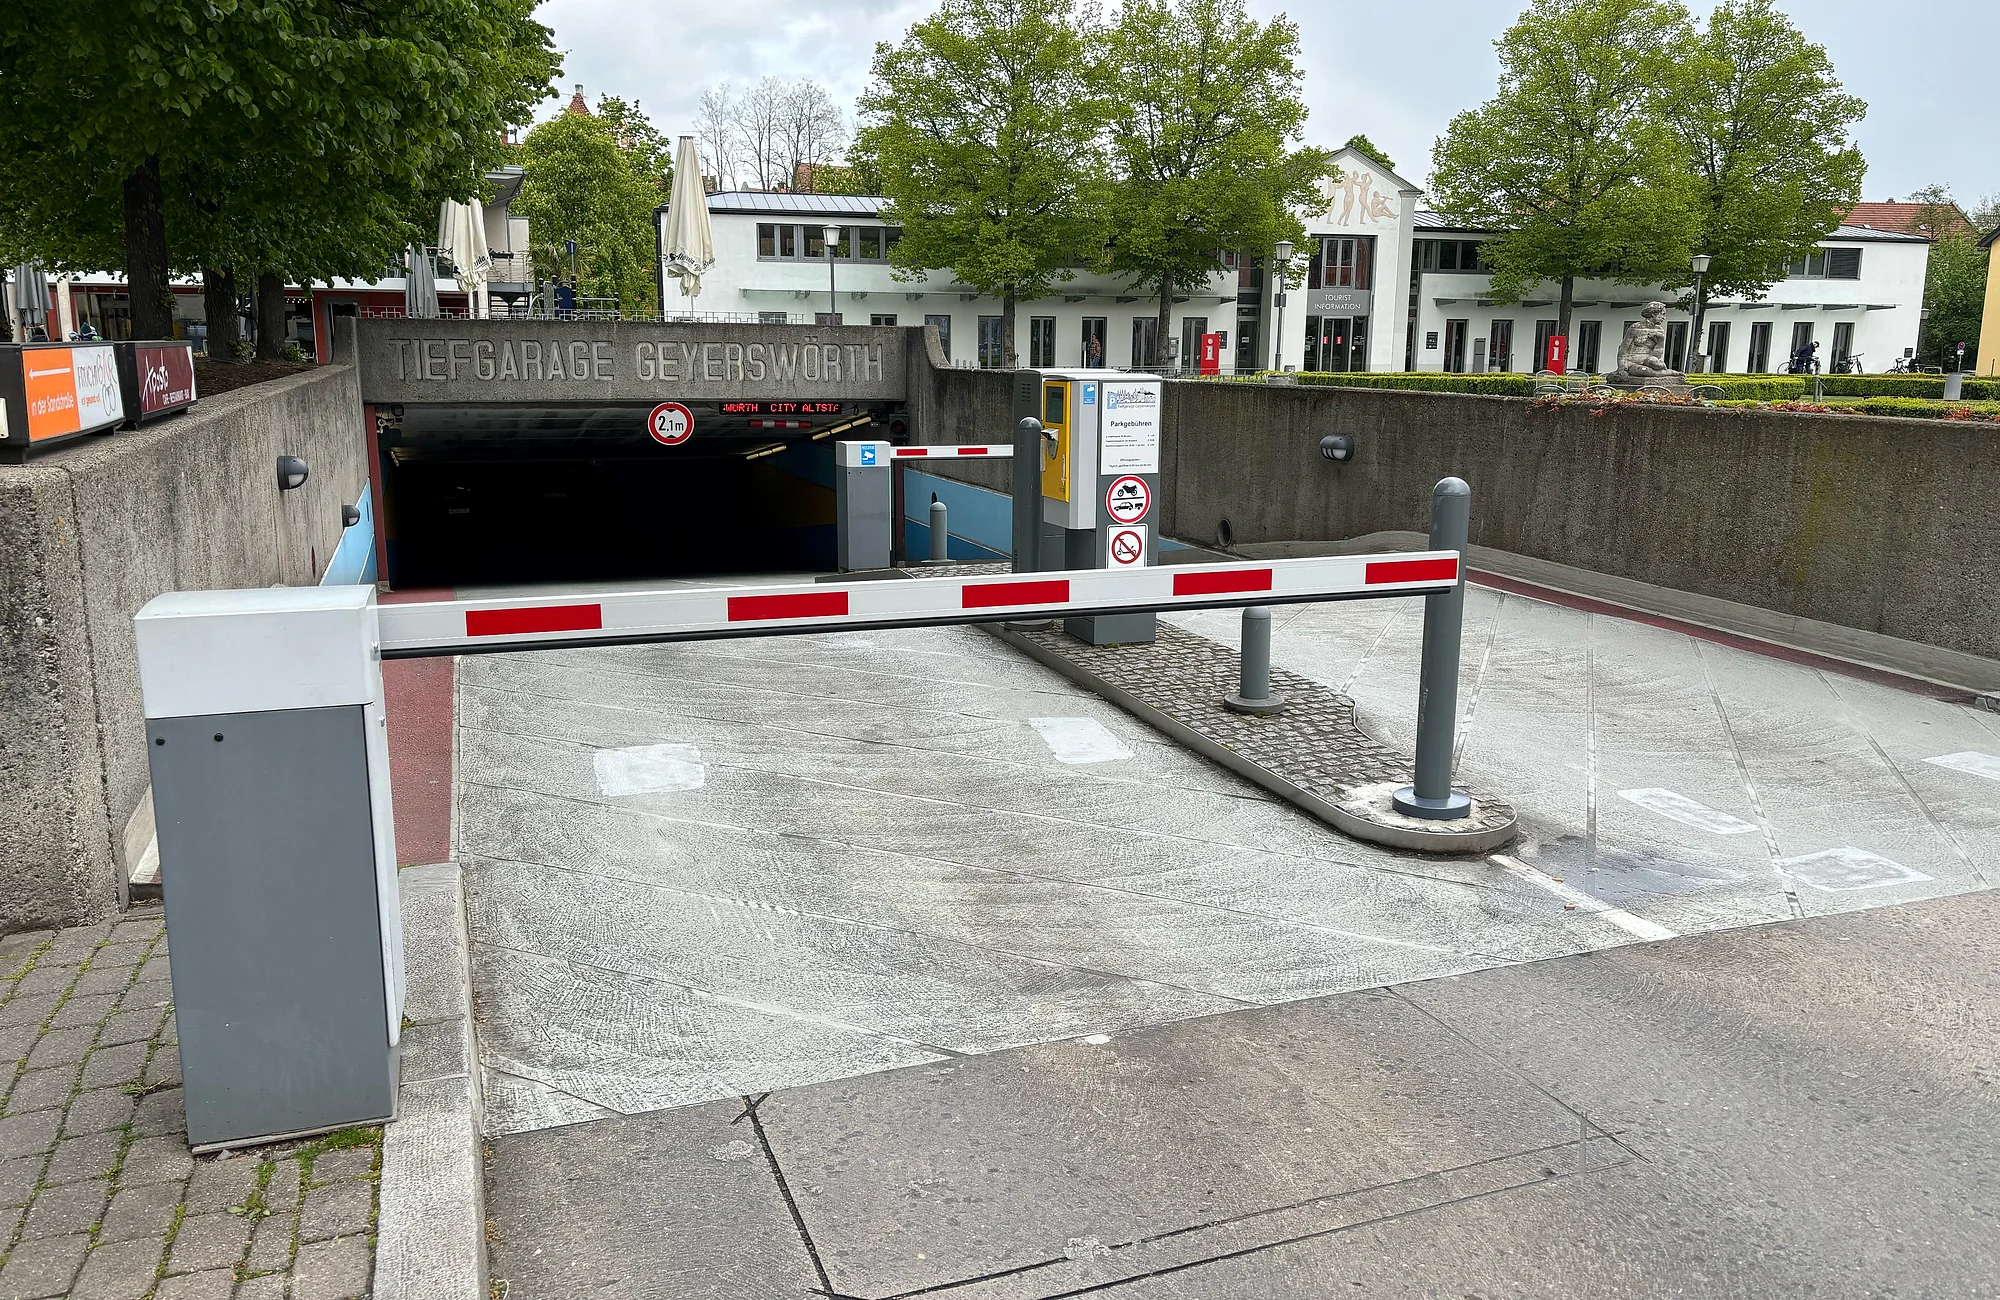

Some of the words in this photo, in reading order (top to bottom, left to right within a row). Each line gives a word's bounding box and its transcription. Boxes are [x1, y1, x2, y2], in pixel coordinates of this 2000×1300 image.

[388, 338, 615, 381] TIEFGARAGE
[635, 335, 883, 382] GEYERSWÖRTH
[770, 403, 797, 412] CITY
[1110, 420, 1152, 429] Parkgebühren
